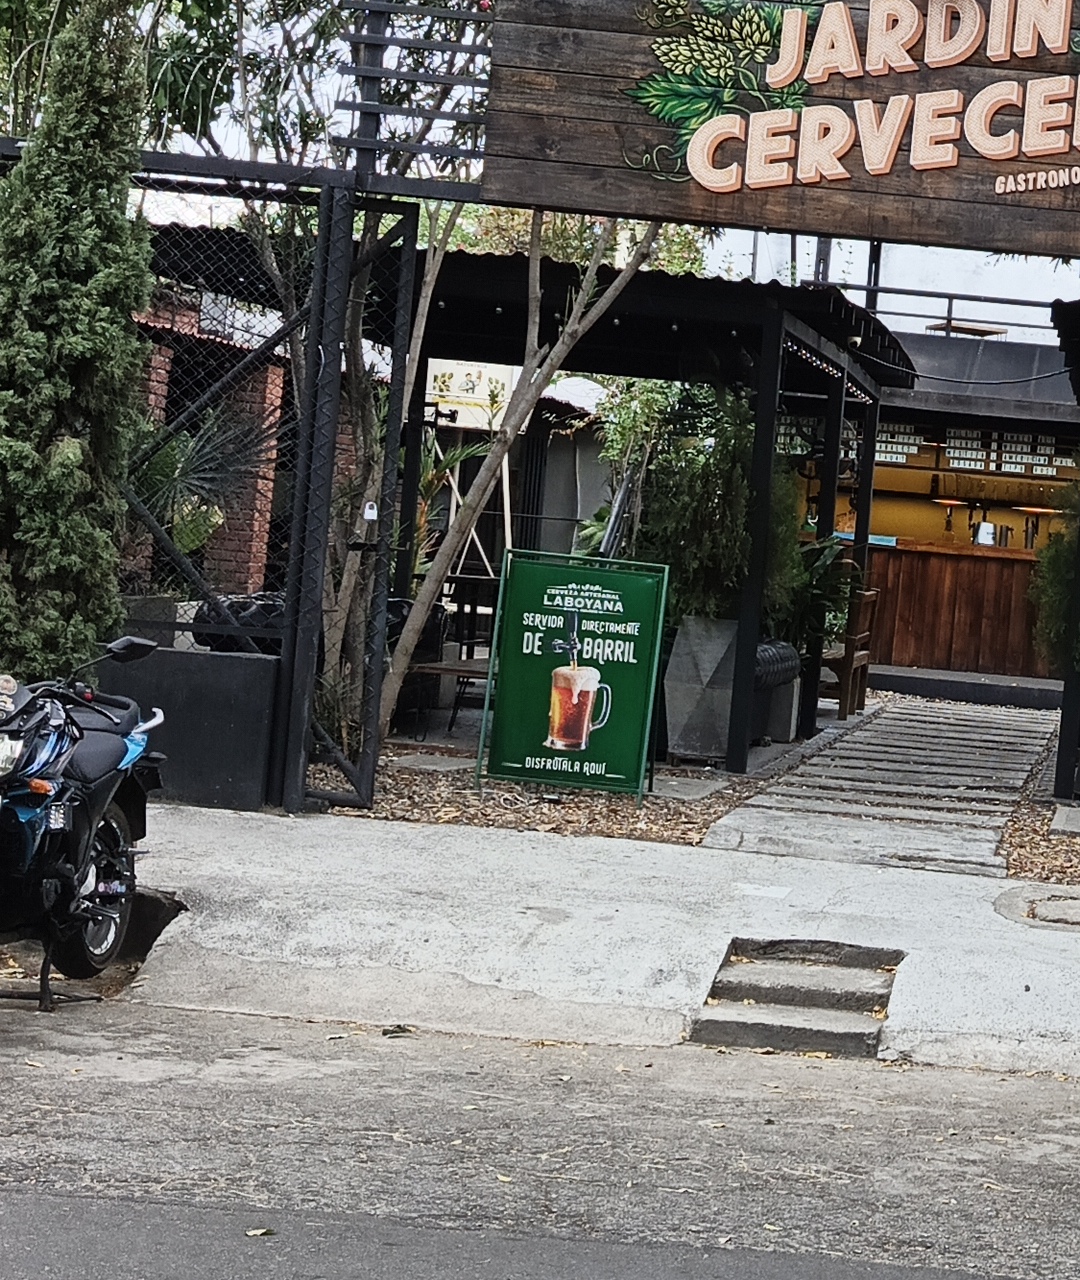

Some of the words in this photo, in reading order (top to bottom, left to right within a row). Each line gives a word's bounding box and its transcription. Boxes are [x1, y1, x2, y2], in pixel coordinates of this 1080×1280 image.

[543, 594, 624, 613] LABOYANA
[522, 612, 565, 631] SERVIDA
[581, 619, 641, 636] DIRECTAMENTE
[522, 631, 544, 655] DE
[582, 637, 638, 665] BARRIL
